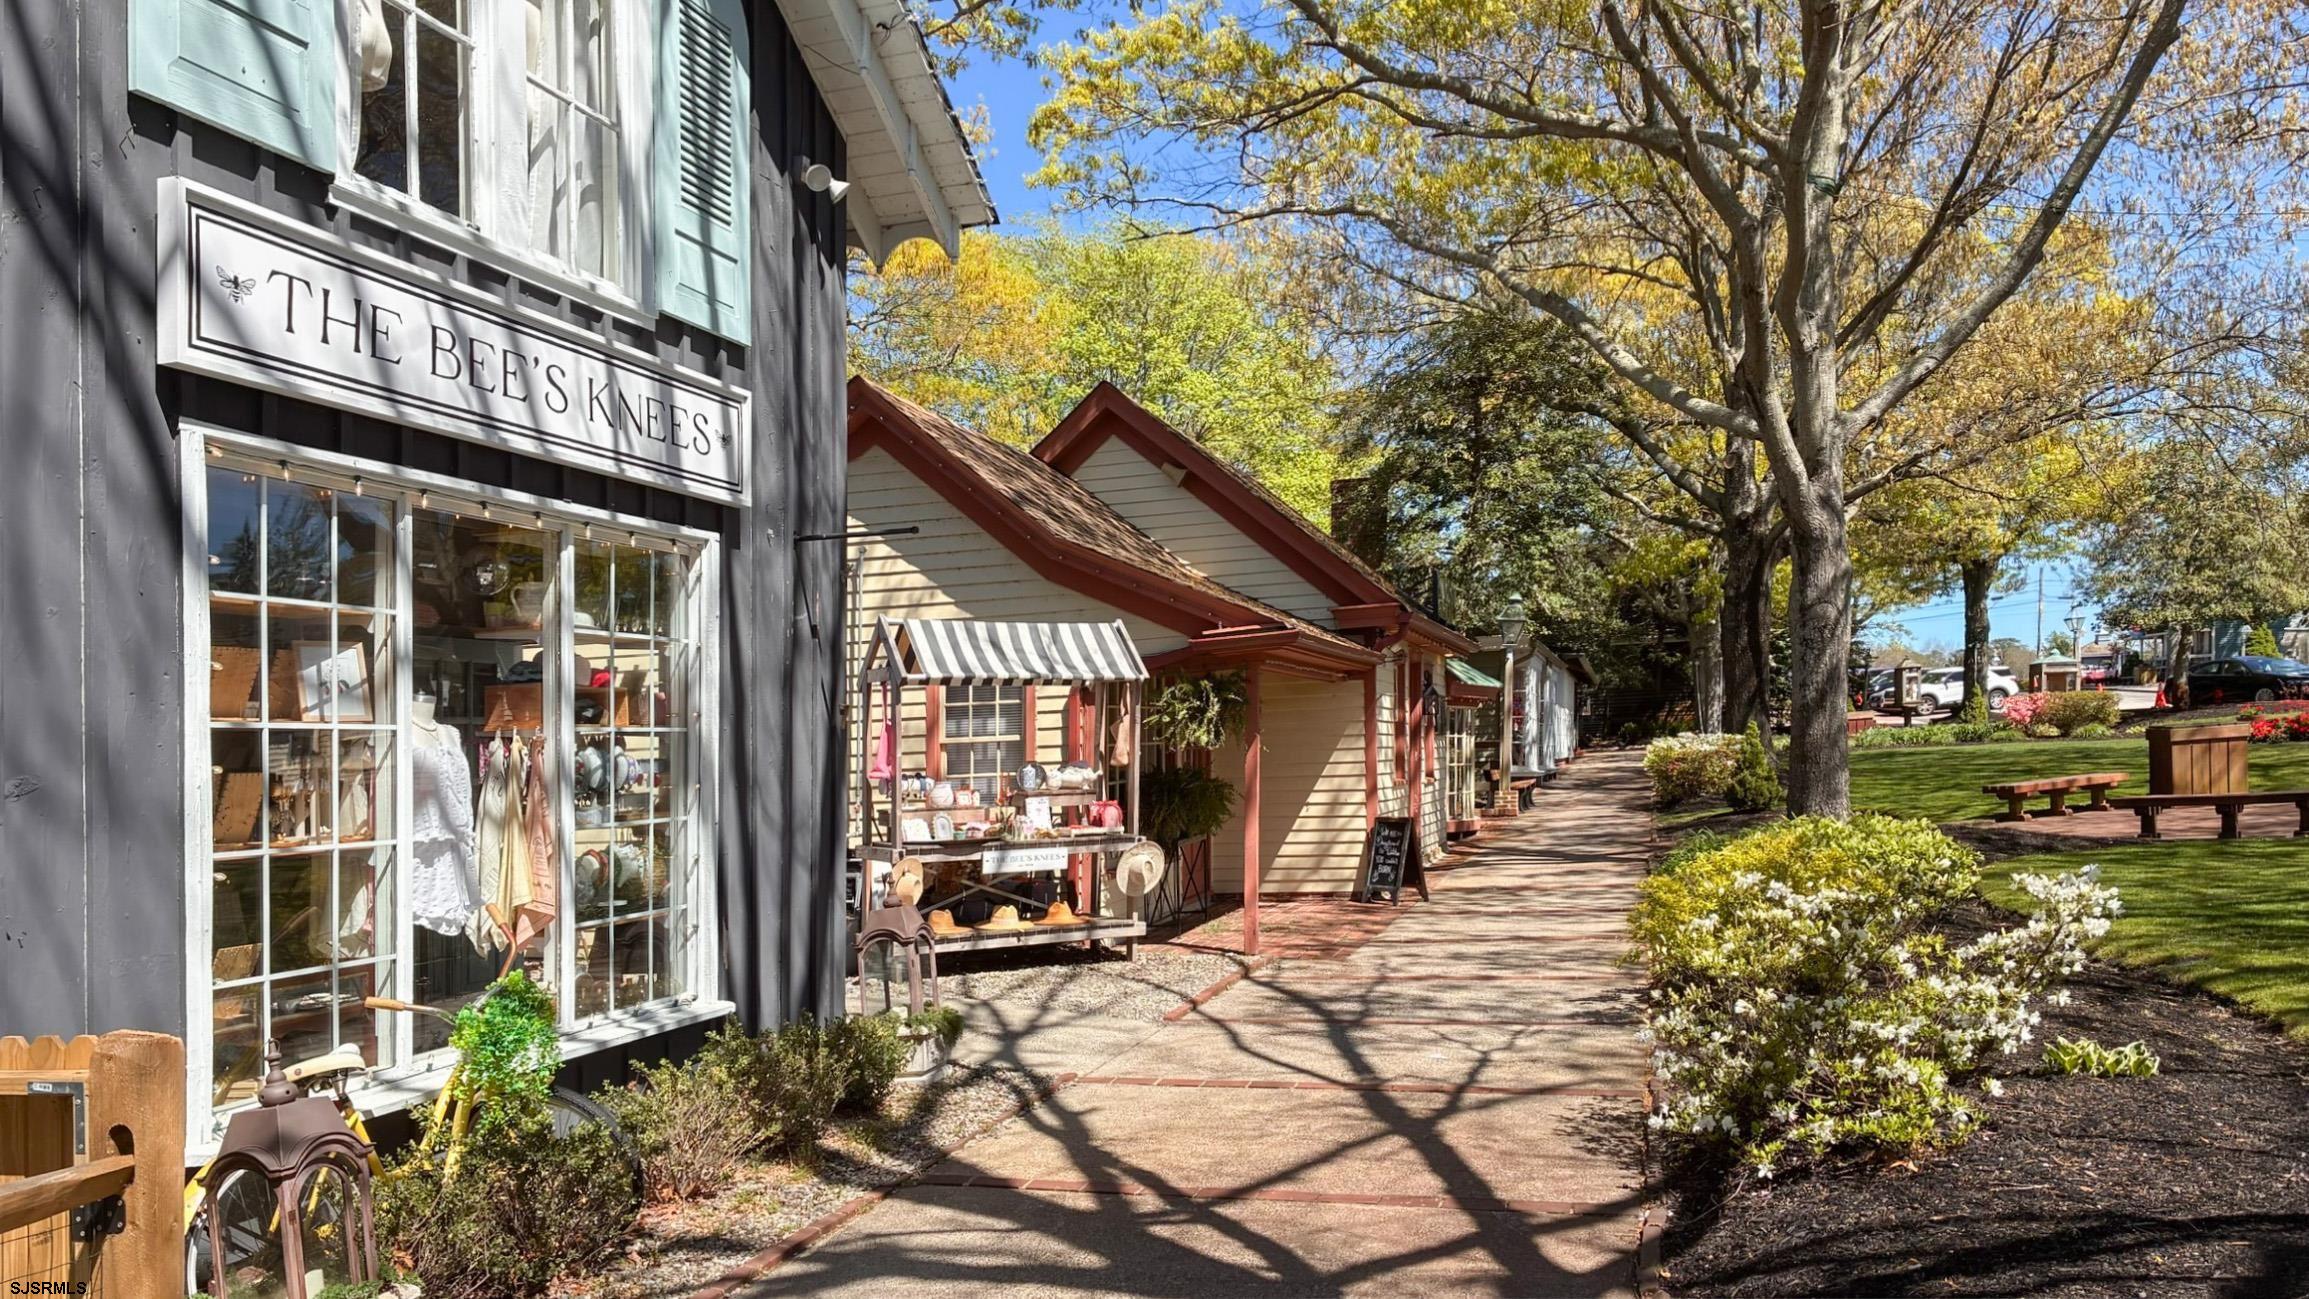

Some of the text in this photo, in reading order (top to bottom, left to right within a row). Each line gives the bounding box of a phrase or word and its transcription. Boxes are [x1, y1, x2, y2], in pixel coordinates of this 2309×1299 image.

[266, 269, 711, 457] THE BEE'S KNEES
